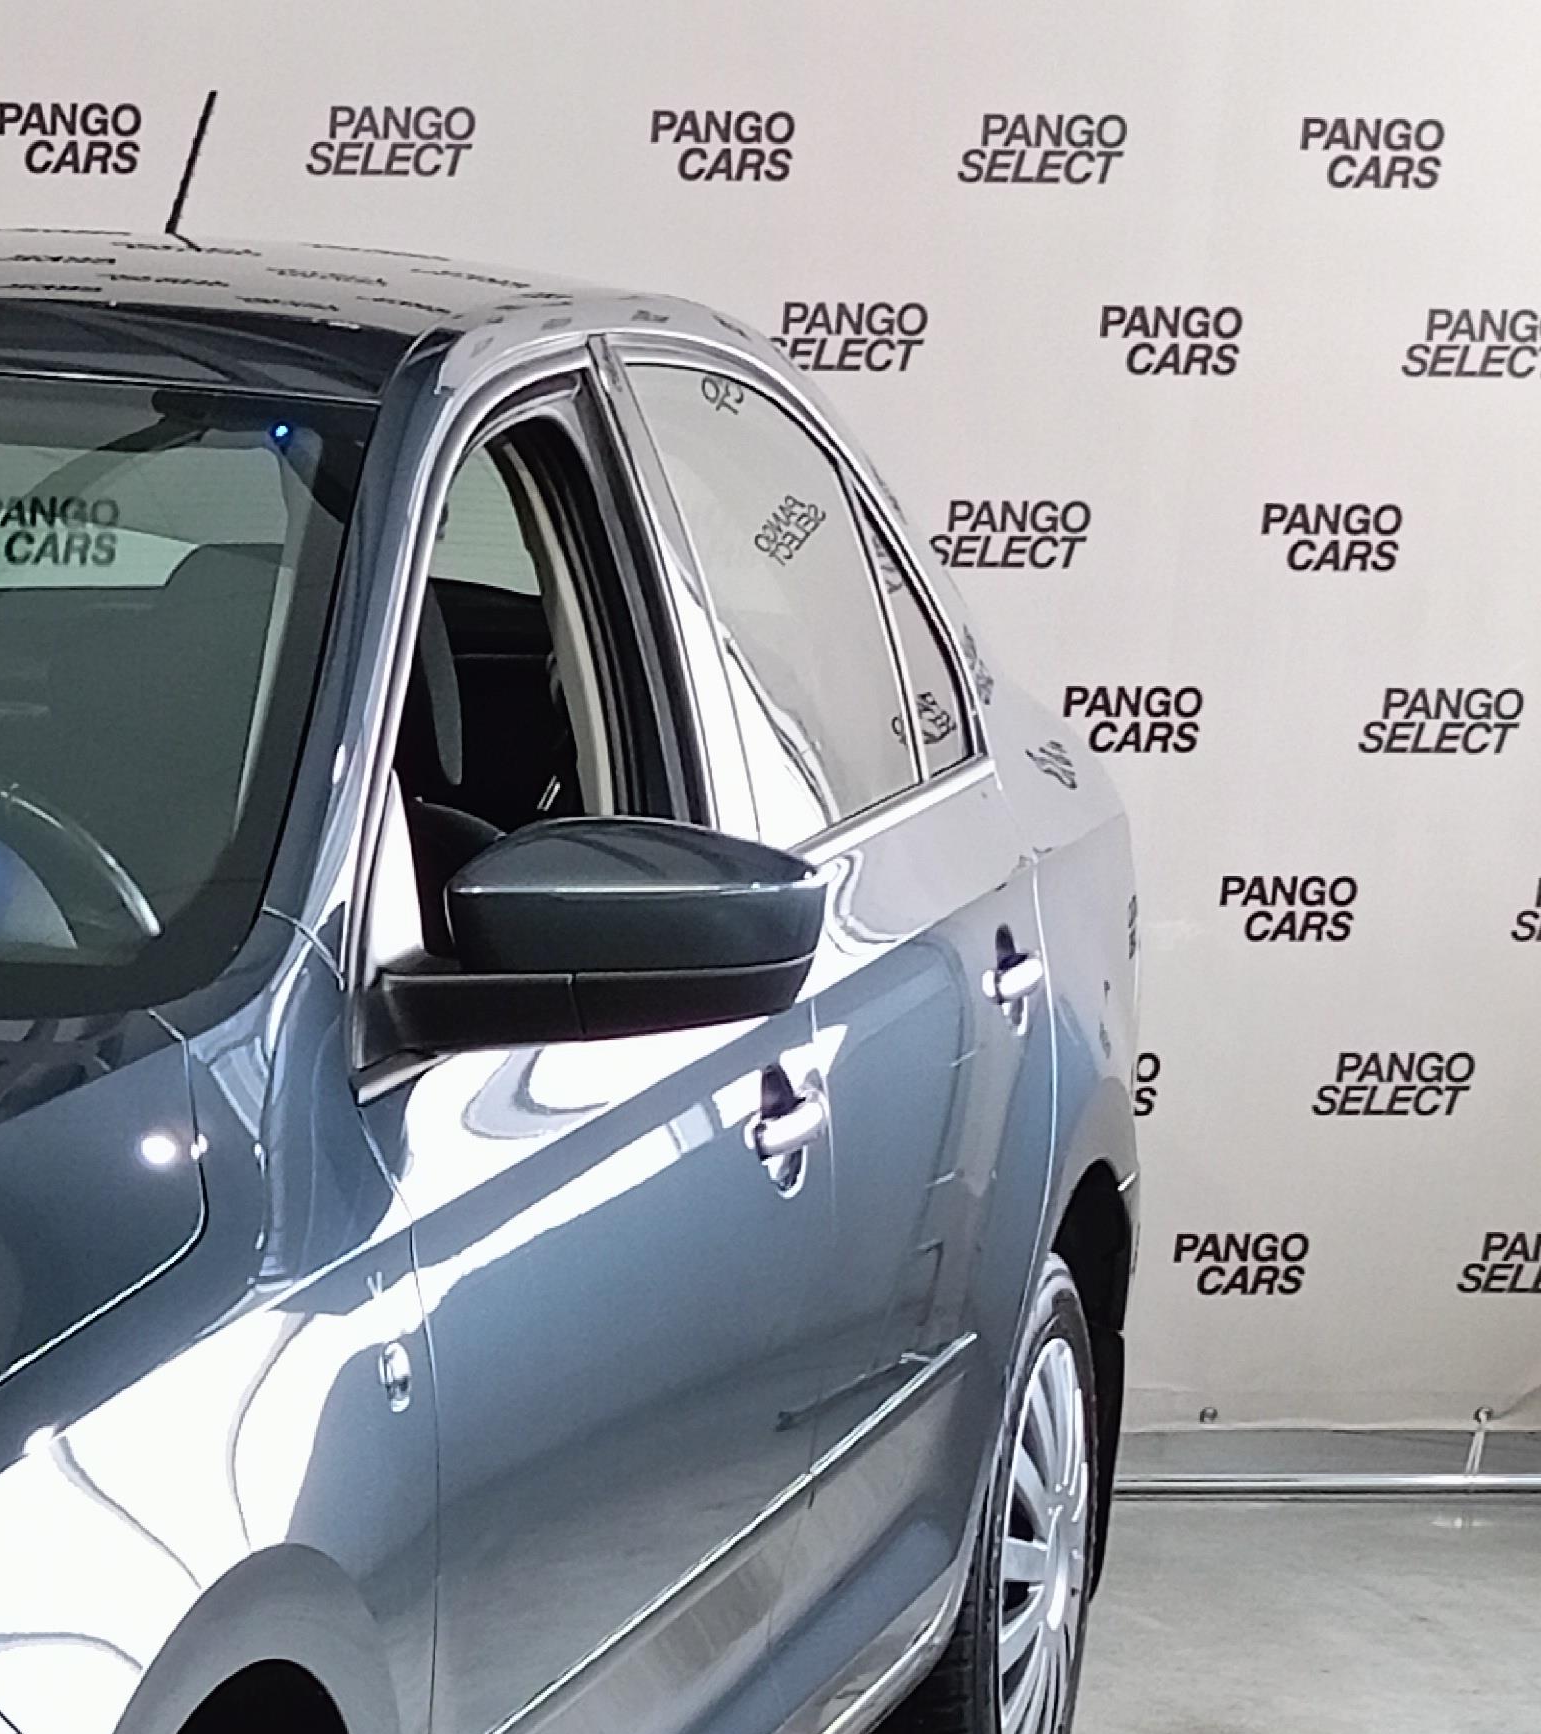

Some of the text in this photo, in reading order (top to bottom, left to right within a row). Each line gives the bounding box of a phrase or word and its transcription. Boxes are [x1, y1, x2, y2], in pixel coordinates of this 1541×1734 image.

[329, 106, 475, 140] PANGO
[651, 110, 795, 144] PANGO
[981, 114, 1127, 148] PANGO
[1300, 117, 1444, 152] PANGO
[25, 140, 140, 174] CARS
[306, 142, 472, 177] SELECT
[678, 148, 792, 181] CARS
[958, 149, 1124, 184] SELECT
[1327, 155, 1441, 188] CARS
[782, 302, 928, 336] PANGO
[1100, 305, 1242, 340] PANGO
[1426, 308, 1541, 343] PANG
[1127, 342, 1239, 375] CARS
[1402, 343, 1541, 378] SELEC
[948, 500, 1091, 534] PANGO
[1261, 503, 1402, 536] PANGO
[5, 531, 117, 565] CARS
[929, 534, 1087, 569] SELECT
[1287, 540, 1399, 572] CARS
[1063, 686, 1203, 719] PANGO
[1382, 688, 1524, 720] PANGO
[1089, 721, 1200, 753] CARS
[1358, 722, 1519, 753] SELECT
[1220, 876, 1358, 907] PANGO
[1245, 911, 1354, 942] CARS
[1336, 1052, 1475, 1083] PANGO
[1312, 1086, 1471, 1116] SELECT
[1174, 1232, 1309, 1263] PANGO
[1197, 1265, 1305, 1295] CARS
